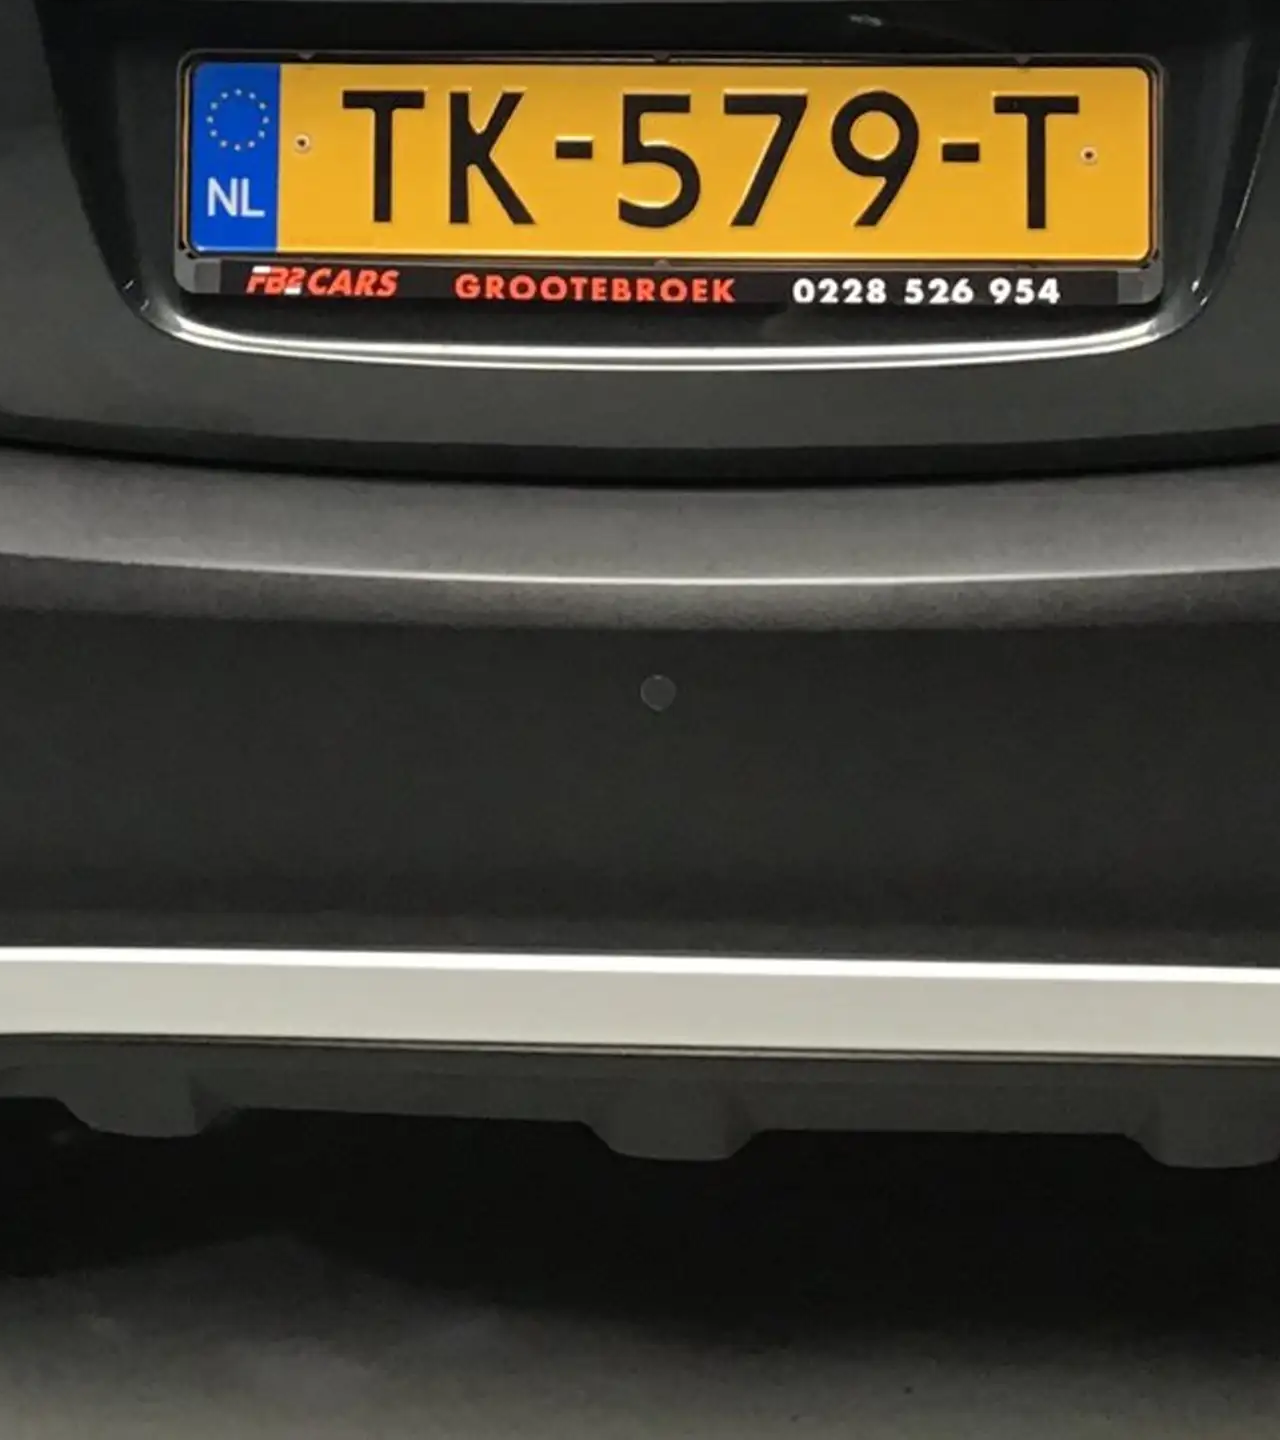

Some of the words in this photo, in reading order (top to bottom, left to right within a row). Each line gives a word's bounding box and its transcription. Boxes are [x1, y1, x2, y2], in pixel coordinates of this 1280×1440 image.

[342, 88, 1080, 230] TK-579-T
[207, 177, 266, 218] NL
[455, 273, 736, 303] GROOTEBROEK
[792, 277, 887, 305] 0228
[904, 277, 975, 305] 526
[989, 277, 1062, 305] 954
